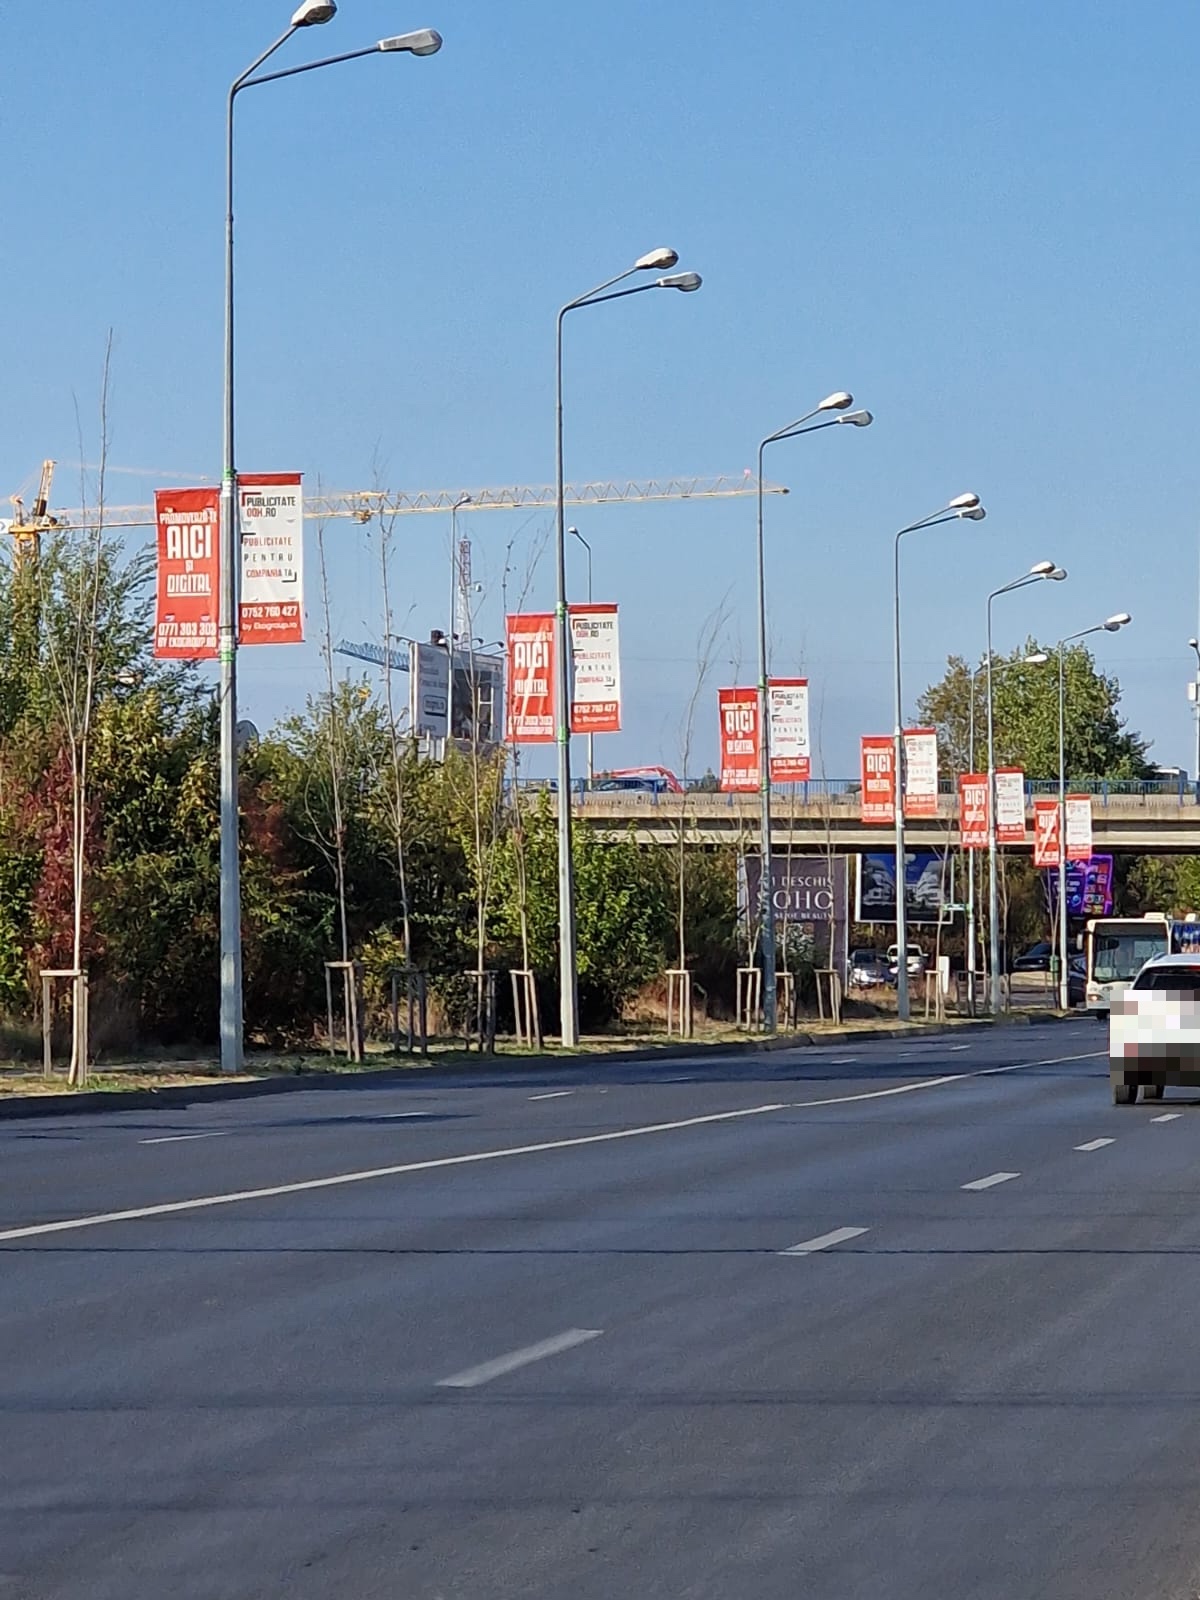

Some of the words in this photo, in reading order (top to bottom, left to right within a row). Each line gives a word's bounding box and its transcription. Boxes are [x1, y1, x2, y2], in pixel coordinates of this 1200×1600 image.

[246, 496, 296, 507] PUBLICITATE
[167, 525, 212, 559] AICI
[244, 537, 292, 547] PUBLICITATE
[244, 553, 293, 562] PENTRU
[246, 569, 282, 578] COMPANIA
[284, 569, 292, 577] TA
[167, 573, 212, 593] DIGITAL
[242, 607, 263, 618] 0752
[281, 605, 298, 617] 427
[158, 622, 178, 636] 0771
[180, 622, 198, 636] 303
[199, 622, 217, 636] 303
[514, 642, 549, 668] AICI
[867, 755, 890, 772] AICI
